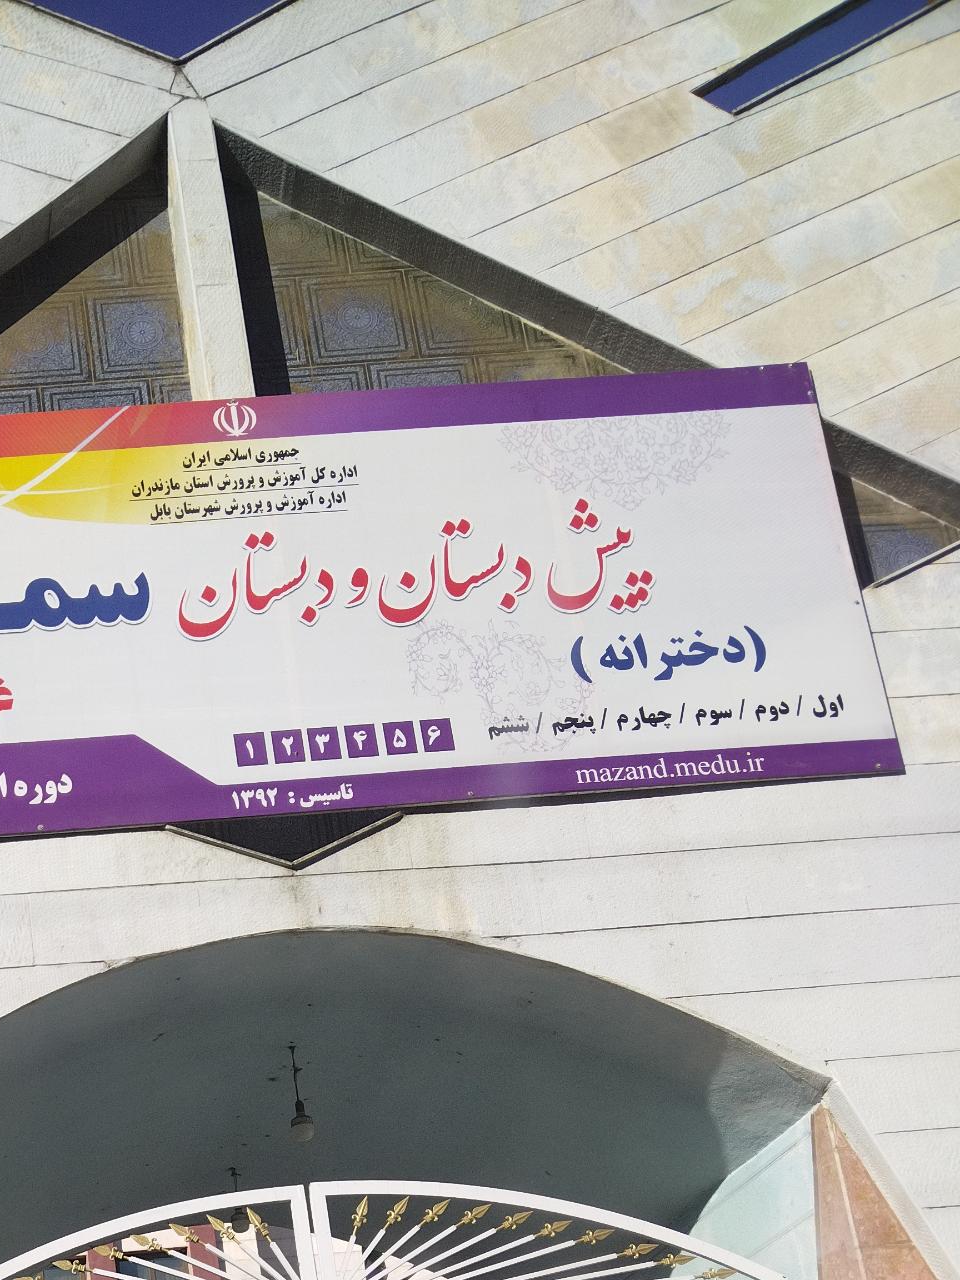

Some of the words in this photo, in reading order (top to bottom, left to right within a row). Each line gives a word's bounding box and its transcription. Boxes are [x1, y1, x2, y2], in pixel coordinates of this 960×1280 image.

[182, 450, 211, 469] ایران
[214, 446, 252, 467] اسلامی
[255, 447, 300, 464] جمهوری
[183, 474, 214, 493] استان
[217, 473, 255, 491] پرورش
[258, 475, 265, 488] و
[267, 466, 307, 487] آموزش
[311, 466, 326, 484] کل
[330, 464, 358, 483] اداره
[131, 477, 180, 497] مازندران
[174, 499, 221, 519] شهرستان
[224, 498, 263, 516] پرورش
[266, 500, 273, 513] و
[275, 490, 315, 512] آموزش
[319, 490, 347, 508] اداره
[150, 502, 172, 521] بابل
[547, 498, 654, 612] پیش
[378, 518, 533, 626] دبستان
[178, 530, 336, 640] دبستان
[345, 565, 370, 607] و
[695, 706, 733, 726] سوم
[754, 698, 790, 722] دوم
[811, 693, 845, 718] اول
[488, 714, 530, 740] ششم
[551, 712, 594, 737] پنجم
[616, 705, 672, 732] چهارم
[576, 751, 765, 784] mazand.medu.ir
[13, 773, 73, 804] دوره
[232, 787, 278, 810] ۱۳۹۲
